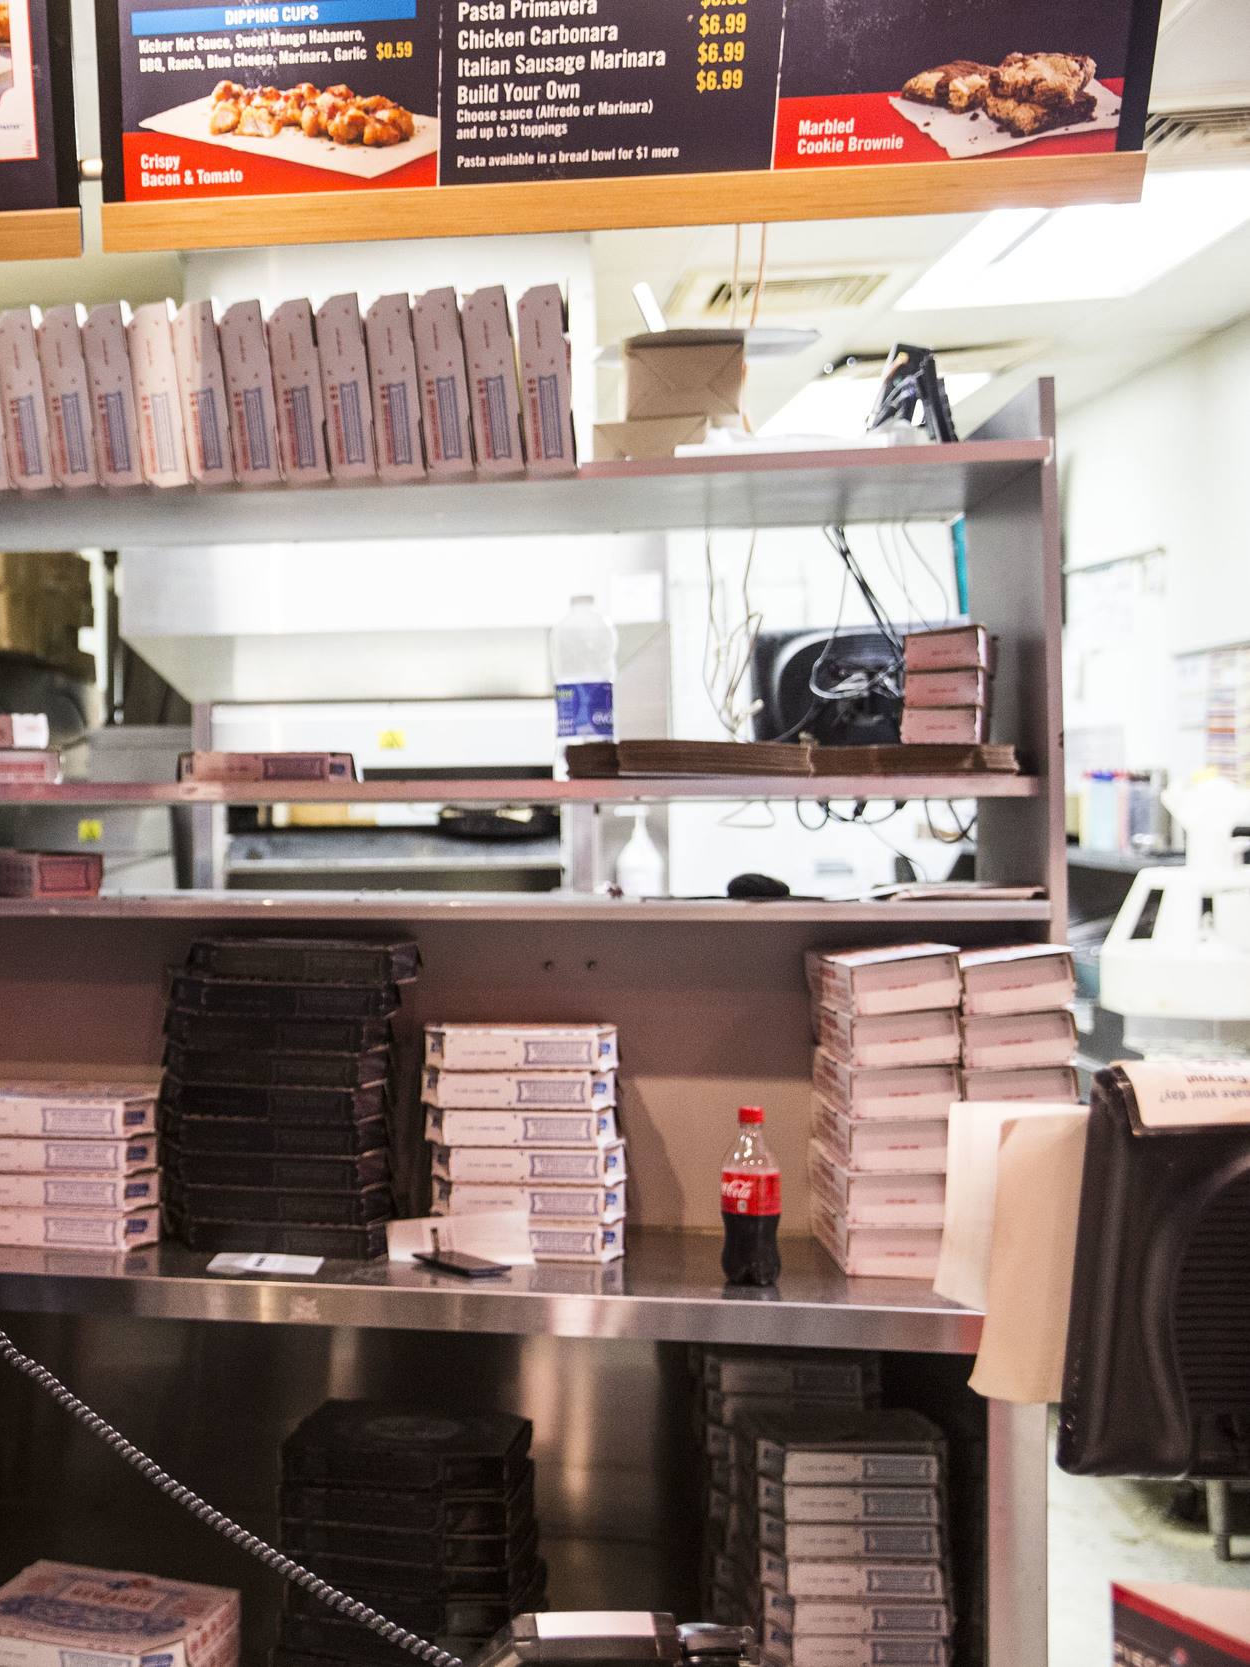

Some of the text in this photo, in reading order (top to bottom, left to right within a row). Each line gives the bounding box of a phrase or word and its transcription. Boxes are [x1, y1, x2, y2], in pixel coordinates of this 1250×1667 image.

[224, 5, 319, 26] DIPPING CUPS
[457, 0, 598, 22] Pasta Primavera
[698, 12, 747, 38] $6.99
[138, 27, 365, 54] Kicker Hot Sauce, Sweet Mango Habanero,
[457, 24, 618, 51] Chicken Carbonara
[140, 41, 413, 74] BBQ, Ranch, Blue Cheese, Marinara, Garlic $0.59
[457, 49, 666, 78] Italian Sausage Marinara
[697, 41, 745, 66] $6.99
[457, 80, 581, 105] Build Your Own
[695, 69, 743, 94] $6.99
[456, 99, 653, 124] Choose sauce (Alfredo or Marinara)
[456, 121, 568, 142] and up to 3 toppings
[798, 118, 855, 136] Marbled
[797, 134, 904, 155] Cookie Brownie
[140, 153, 180, 172] Crispy
[456, 146, 680, 169] Pasta available in a bread bowl for $1 more
[141, 168, 243, 187] Bacon & Tomato
[1159, 1088, 1187, 1103] day?
[1191, 1088, 1218, 1100] your
